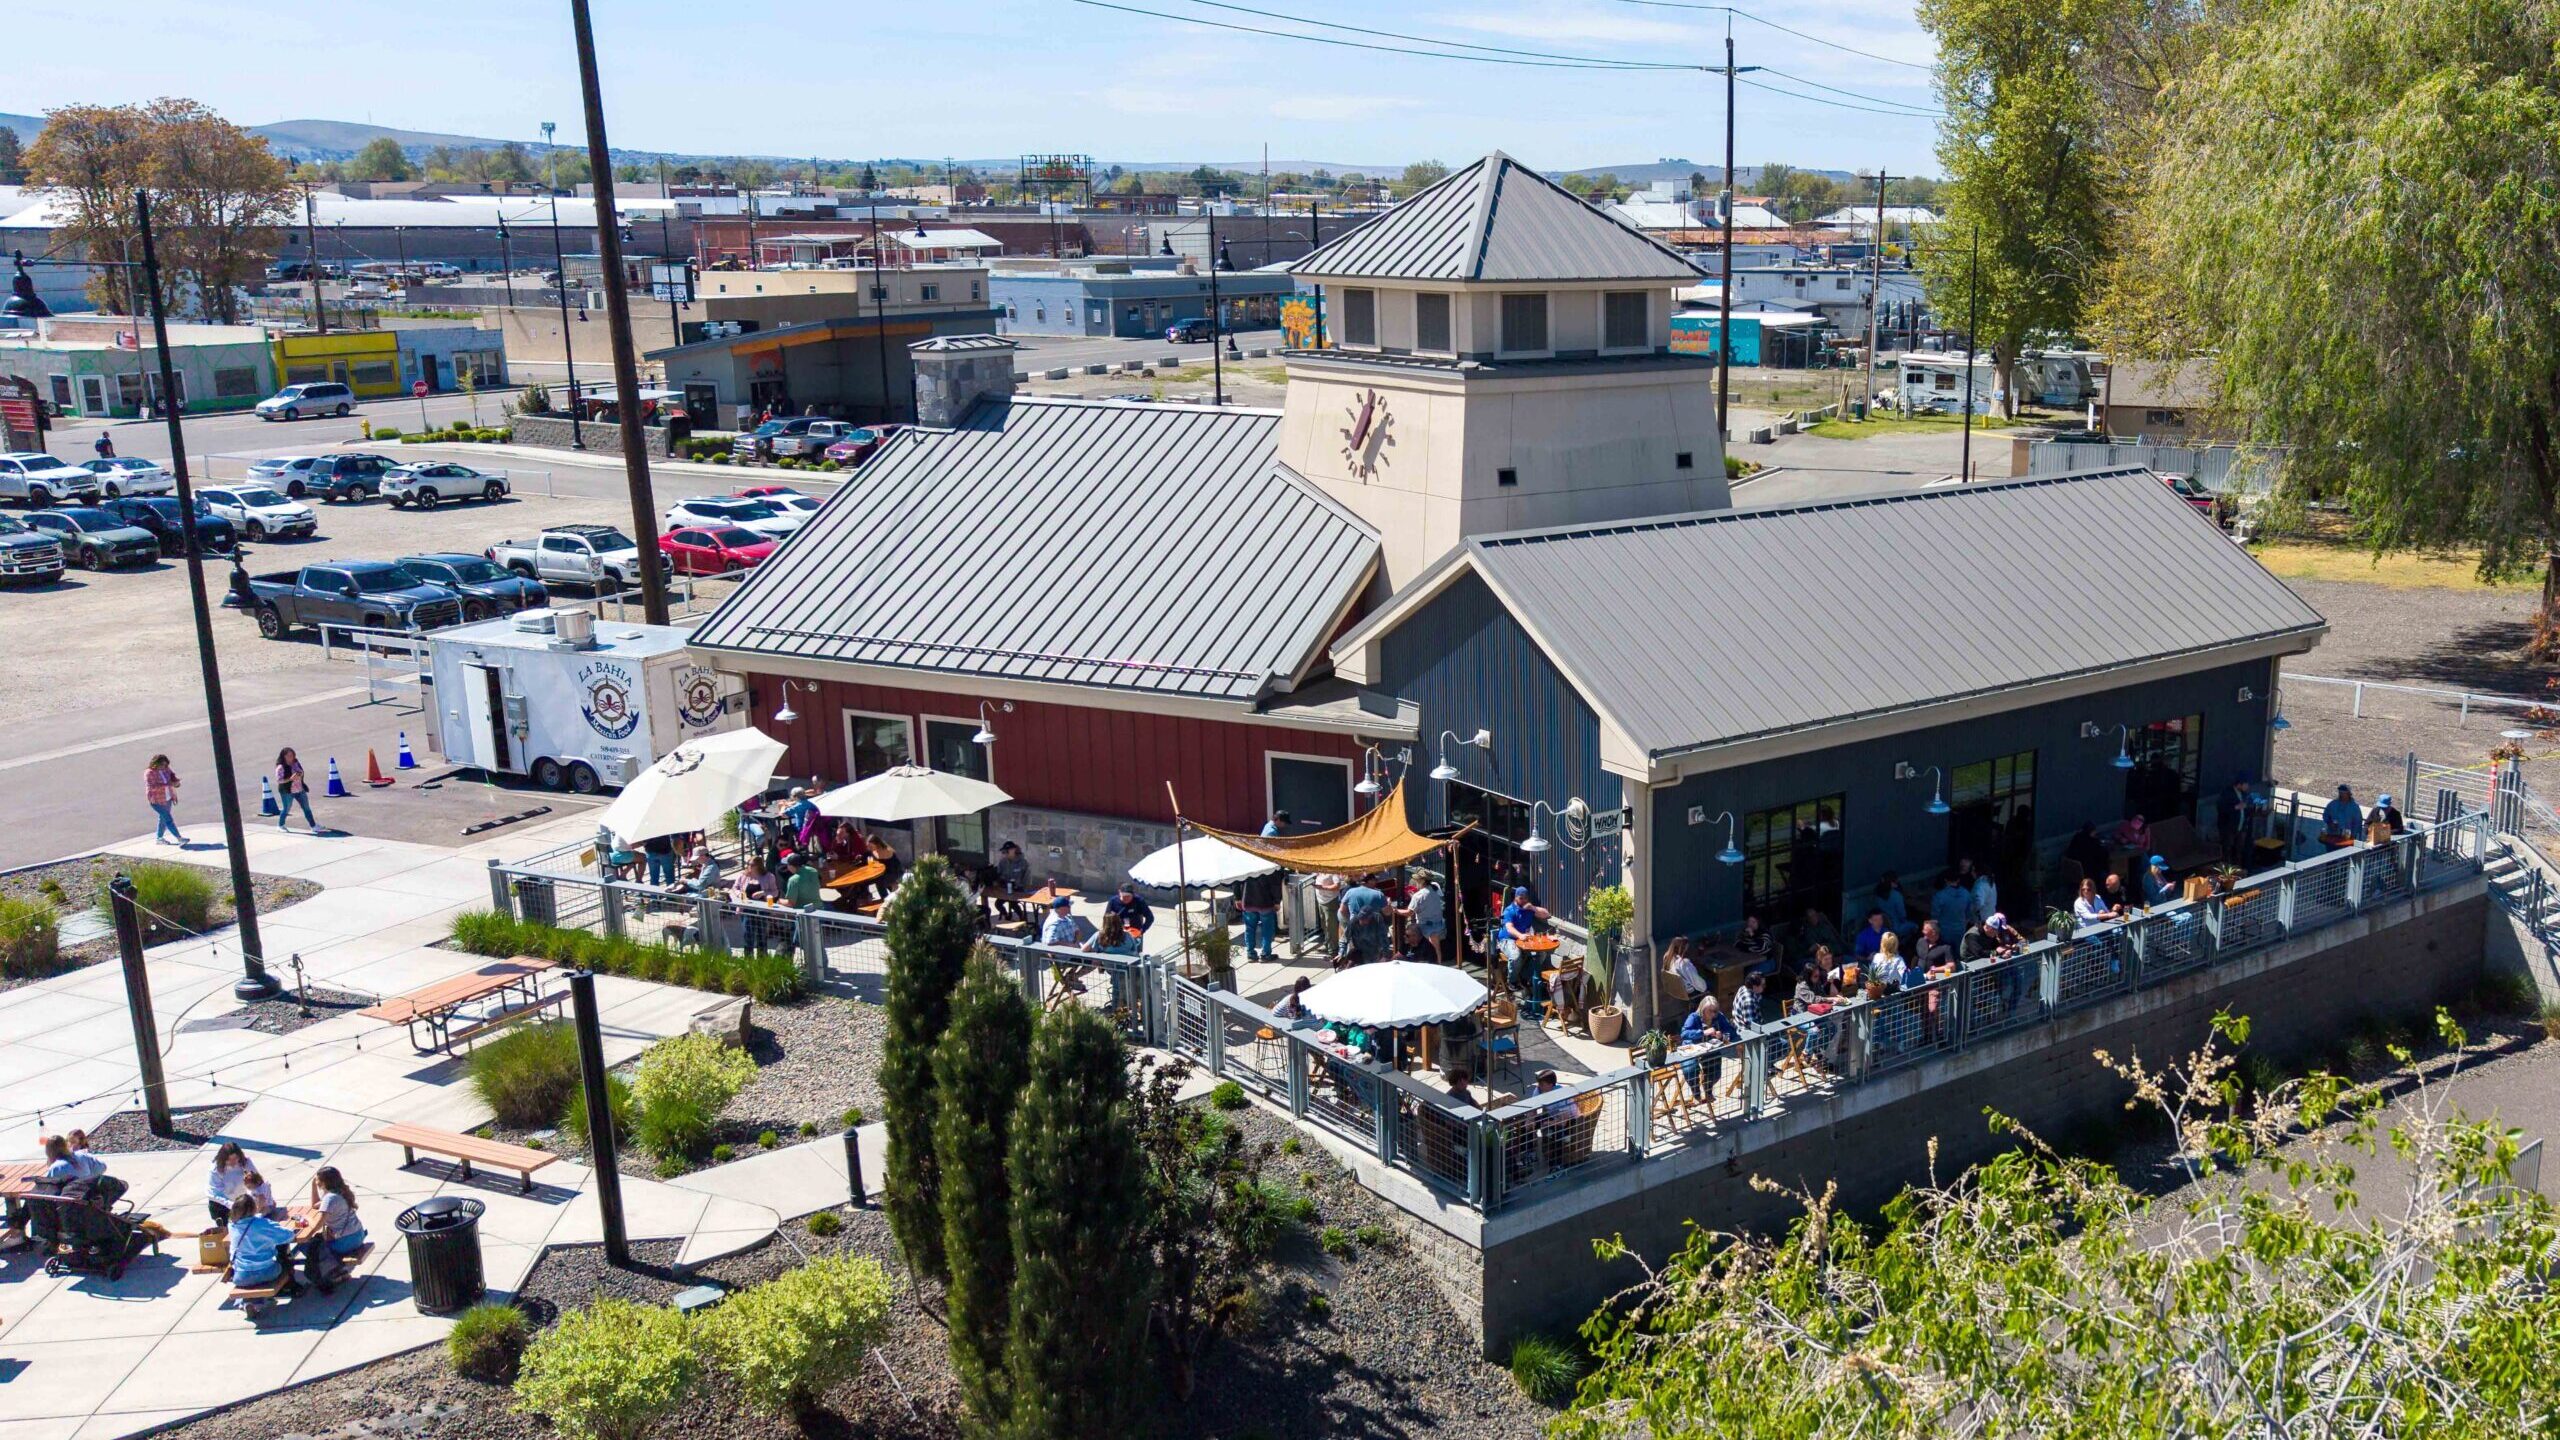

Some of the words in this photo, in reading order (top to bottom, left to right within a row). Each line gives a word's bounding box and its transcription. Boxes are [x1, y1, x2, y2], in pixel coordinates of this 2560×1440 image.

[578, 666, 593, 682] LA
[595, 662, 632, 688] BAHIA
[679, 673, 690, 687] LA
[592, 719, 617, 738] Mexican
[617, 724, 632, 738] Food
